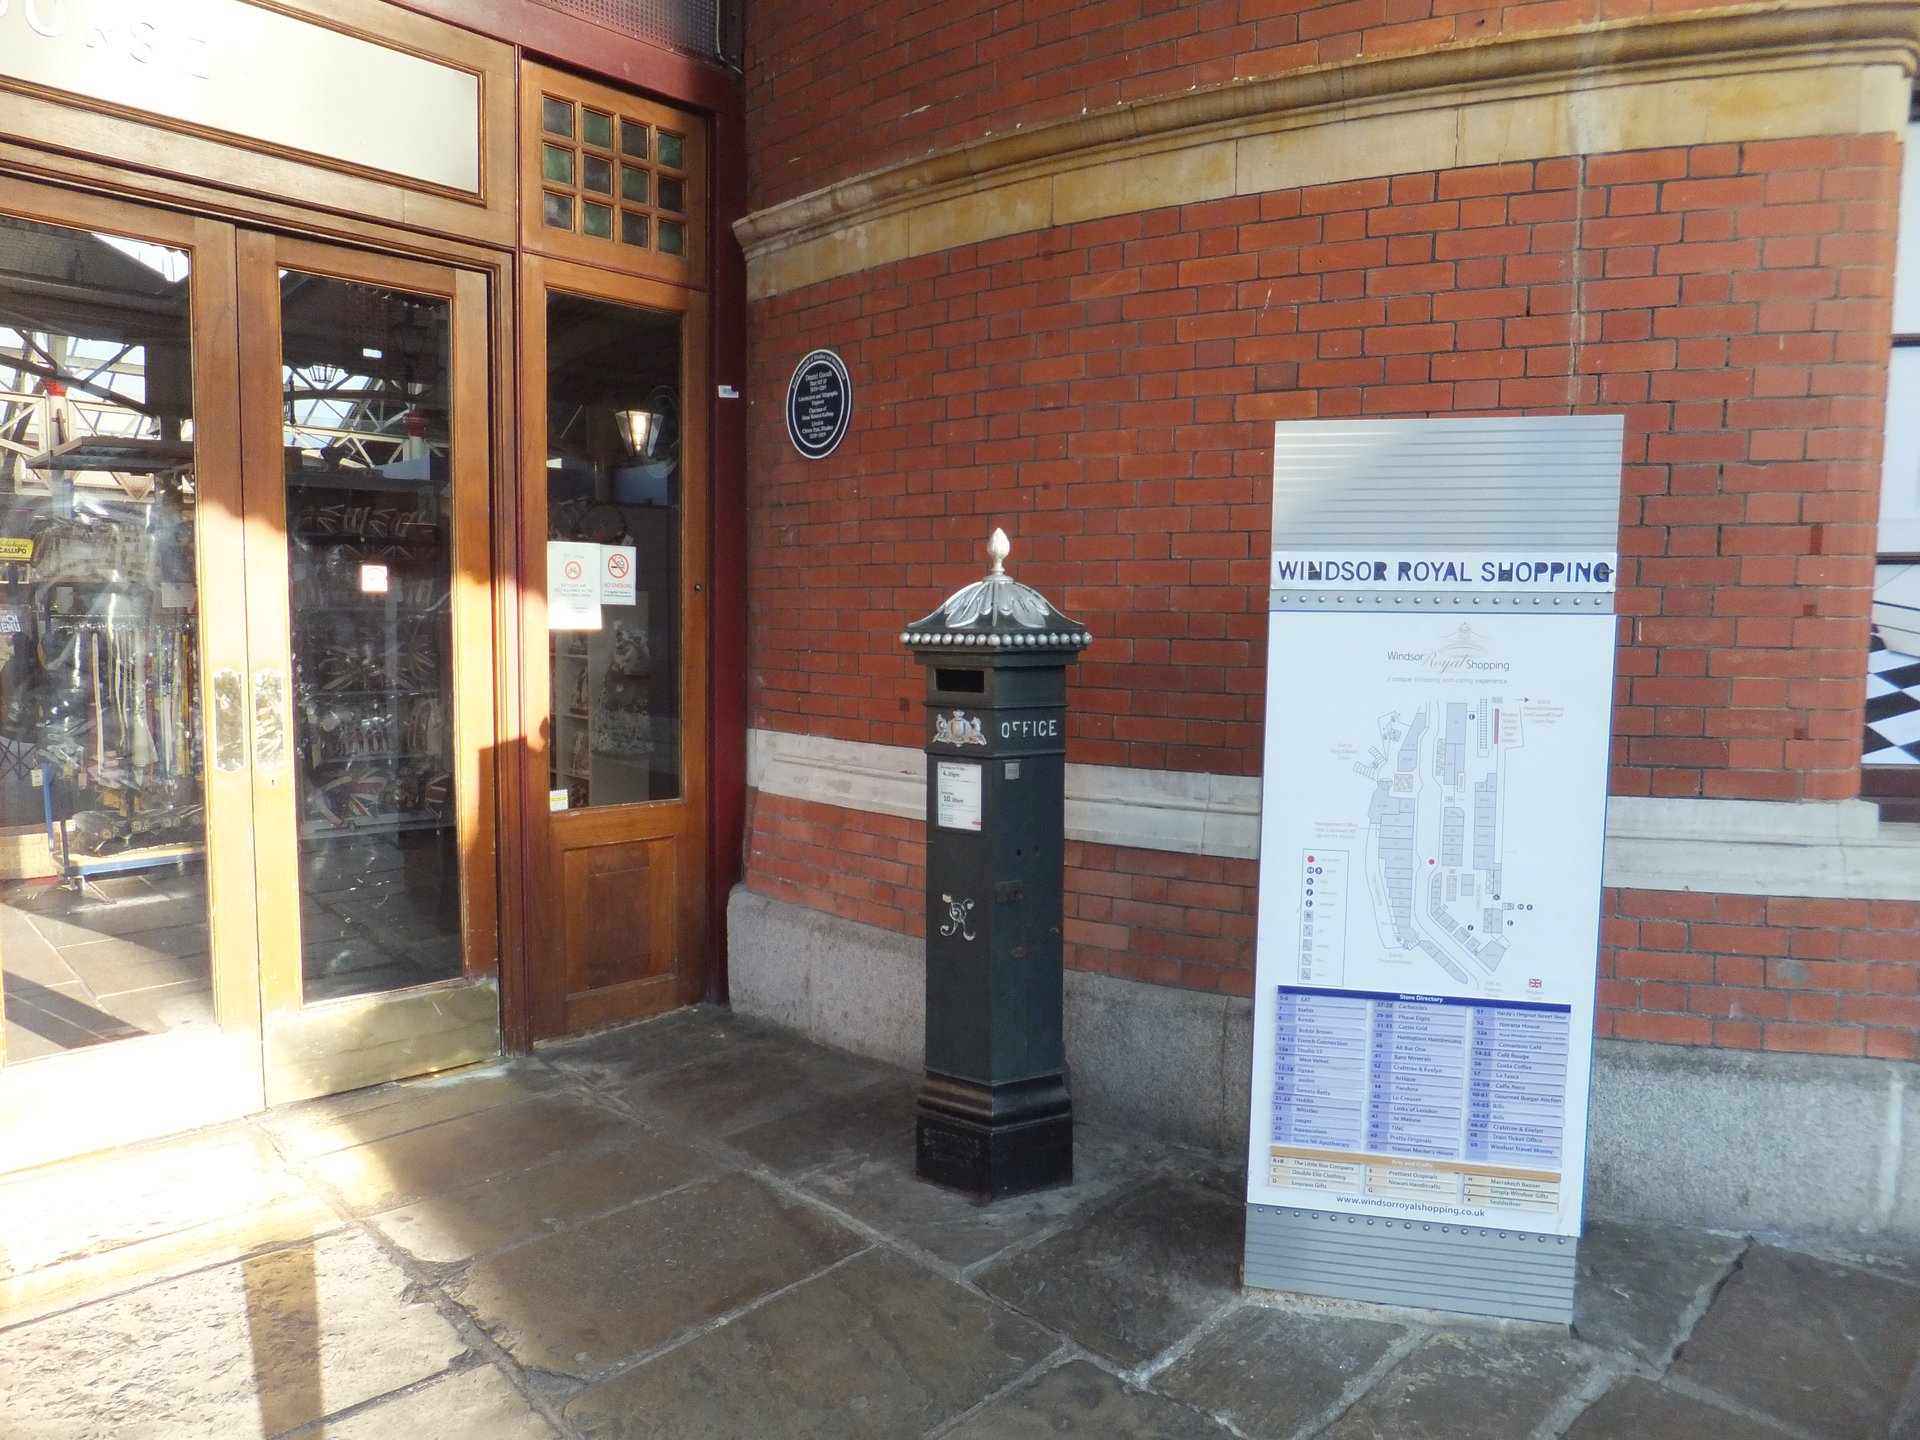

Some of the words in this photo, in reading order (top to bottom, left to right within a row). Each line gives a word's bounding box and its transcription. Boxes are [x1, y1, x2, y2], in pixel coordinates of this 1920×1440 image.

[1278, 561, 1387, 581] WINDSOR
[1398, 561, 1472, 582] ROYAL
[1480, 561, 1611, 584] SHOPPING
[0, 623, 21, 633] ENU
[1387, 650, 1424, 662] Windsor
[1423, 650, 1469, 674] Royal
[1466, 659, 1510, 673] Shopping
[1001, 720, 1058, 739] OFFICE
[1416, 995, 1444, 1004] Directory
[1329, 1163, 1354, 1171] Company
[1336, 1196, 1486, 1217] www.windsorroyalshopping.co.uk
